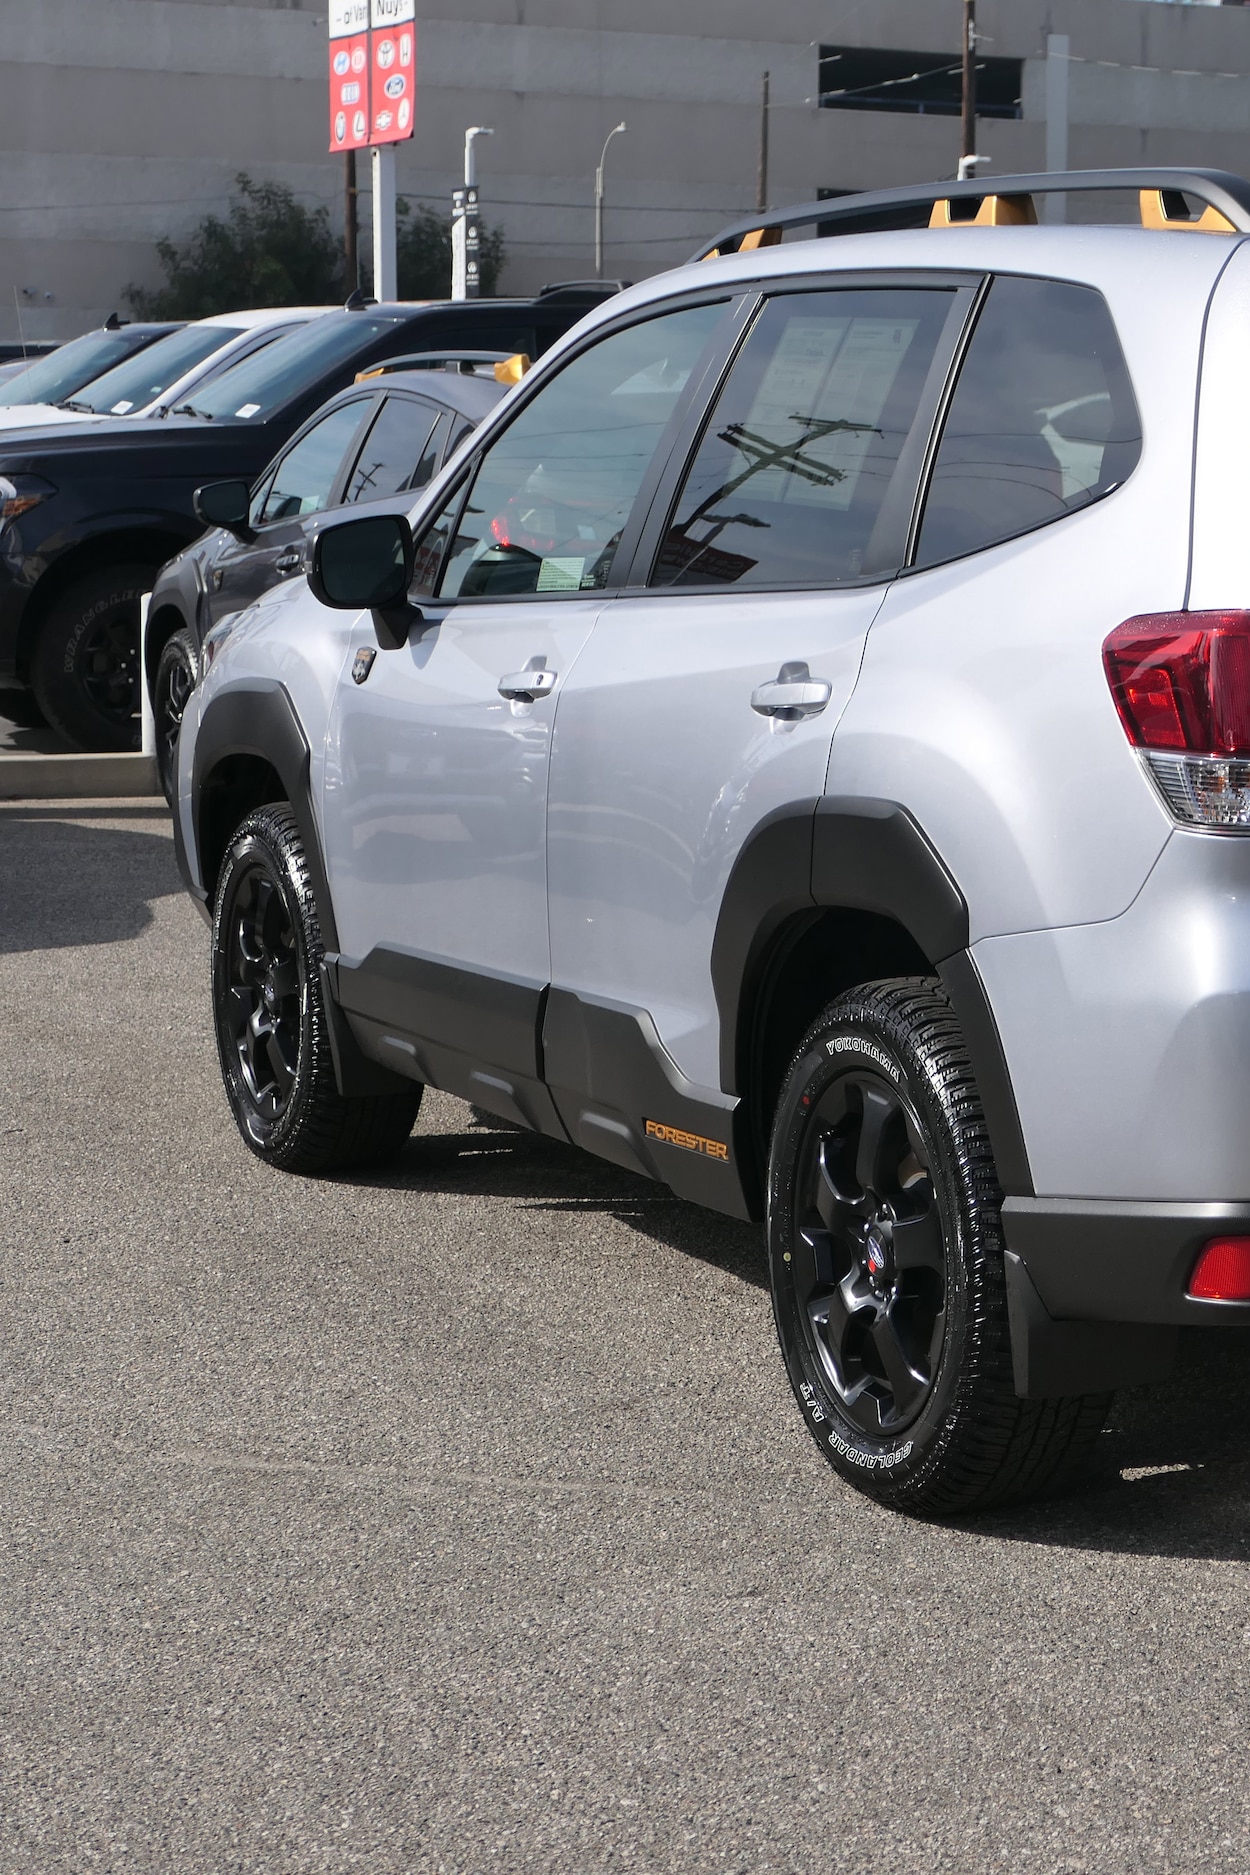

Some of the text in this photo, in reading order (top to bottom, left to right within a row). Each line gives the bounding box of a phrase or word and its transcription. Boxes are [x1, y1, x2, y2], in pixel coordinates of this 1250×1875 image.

[826, 1036, 901, 1083] YOKOHAMA
[645, 1119, 729, 1160] FORESTER
[799, 1382, 914, 1469] GEOLANDAR A/T
